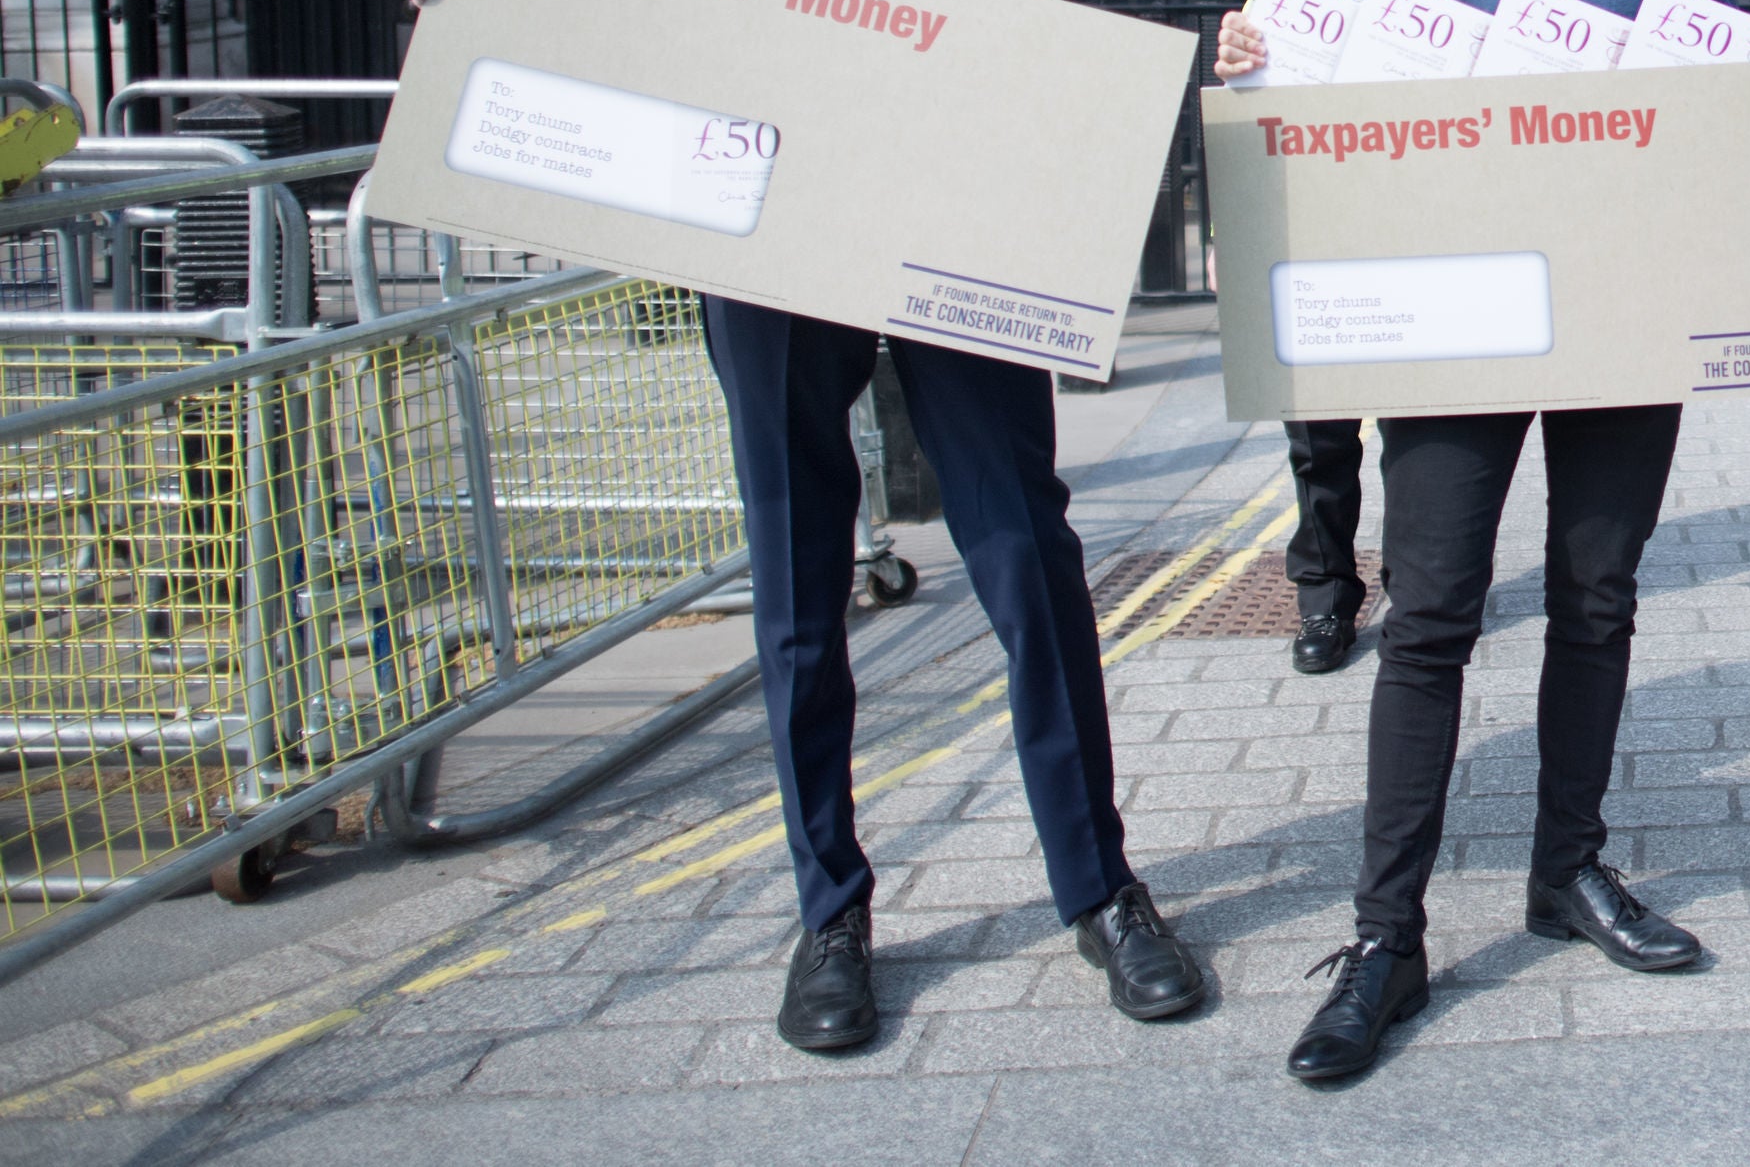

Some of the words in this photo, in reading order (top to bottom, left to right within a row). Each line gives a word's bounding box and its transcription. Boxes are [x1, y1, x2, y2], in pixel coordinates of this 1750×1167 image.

[1508, 0, 1592, 53] £50
[1650, 2, 1732, 57] £50
[491, 81, 515, 98] To:
[485, 100, 525, 122] Tory
[528, 112, 582, 135] chums
[1257, 107, 1492, 162] Taxpayers’
[1509, 105, 1657, 148] Money
[478, 119, 531, 145] Dodgy
[534, 134, 613, 162] contracts
[692, 118, 781, 161] £50
[472, 140, 512, 159] Jobs
[515, 149, 540, 165] for
[542, 157, 593, 178] mates
[1293, 280, 1315, 292] To:
[1295, 298, 1330, 311] Tory
[1333, 296, 1382, 309] chums
[932, 284, 943, 298] IF
[944, 287, 978, 305] FOUND
[980, 295, 1017, 313] PLEASE
[1018, 303, 1056, 323] RETURN
[1059, 312, 1075, 328] TO:
[1297, 315, 1342, 329] Dodgy
[1345, 312, 1415, 326] contracts
[905, 295, 934, 318] THE
[936, 303, 1046, 343] CONSERVATIVE
[1048, 328, 1095, 354] PARTY
[1297, 333, 1332, 346] Jobs
[1335, 332, 1356, 344] for
[1360, 331, 1404, 343] mates
[1723, 345, 1732, 356] IF
[1703, 361, 1729, 378] THE
